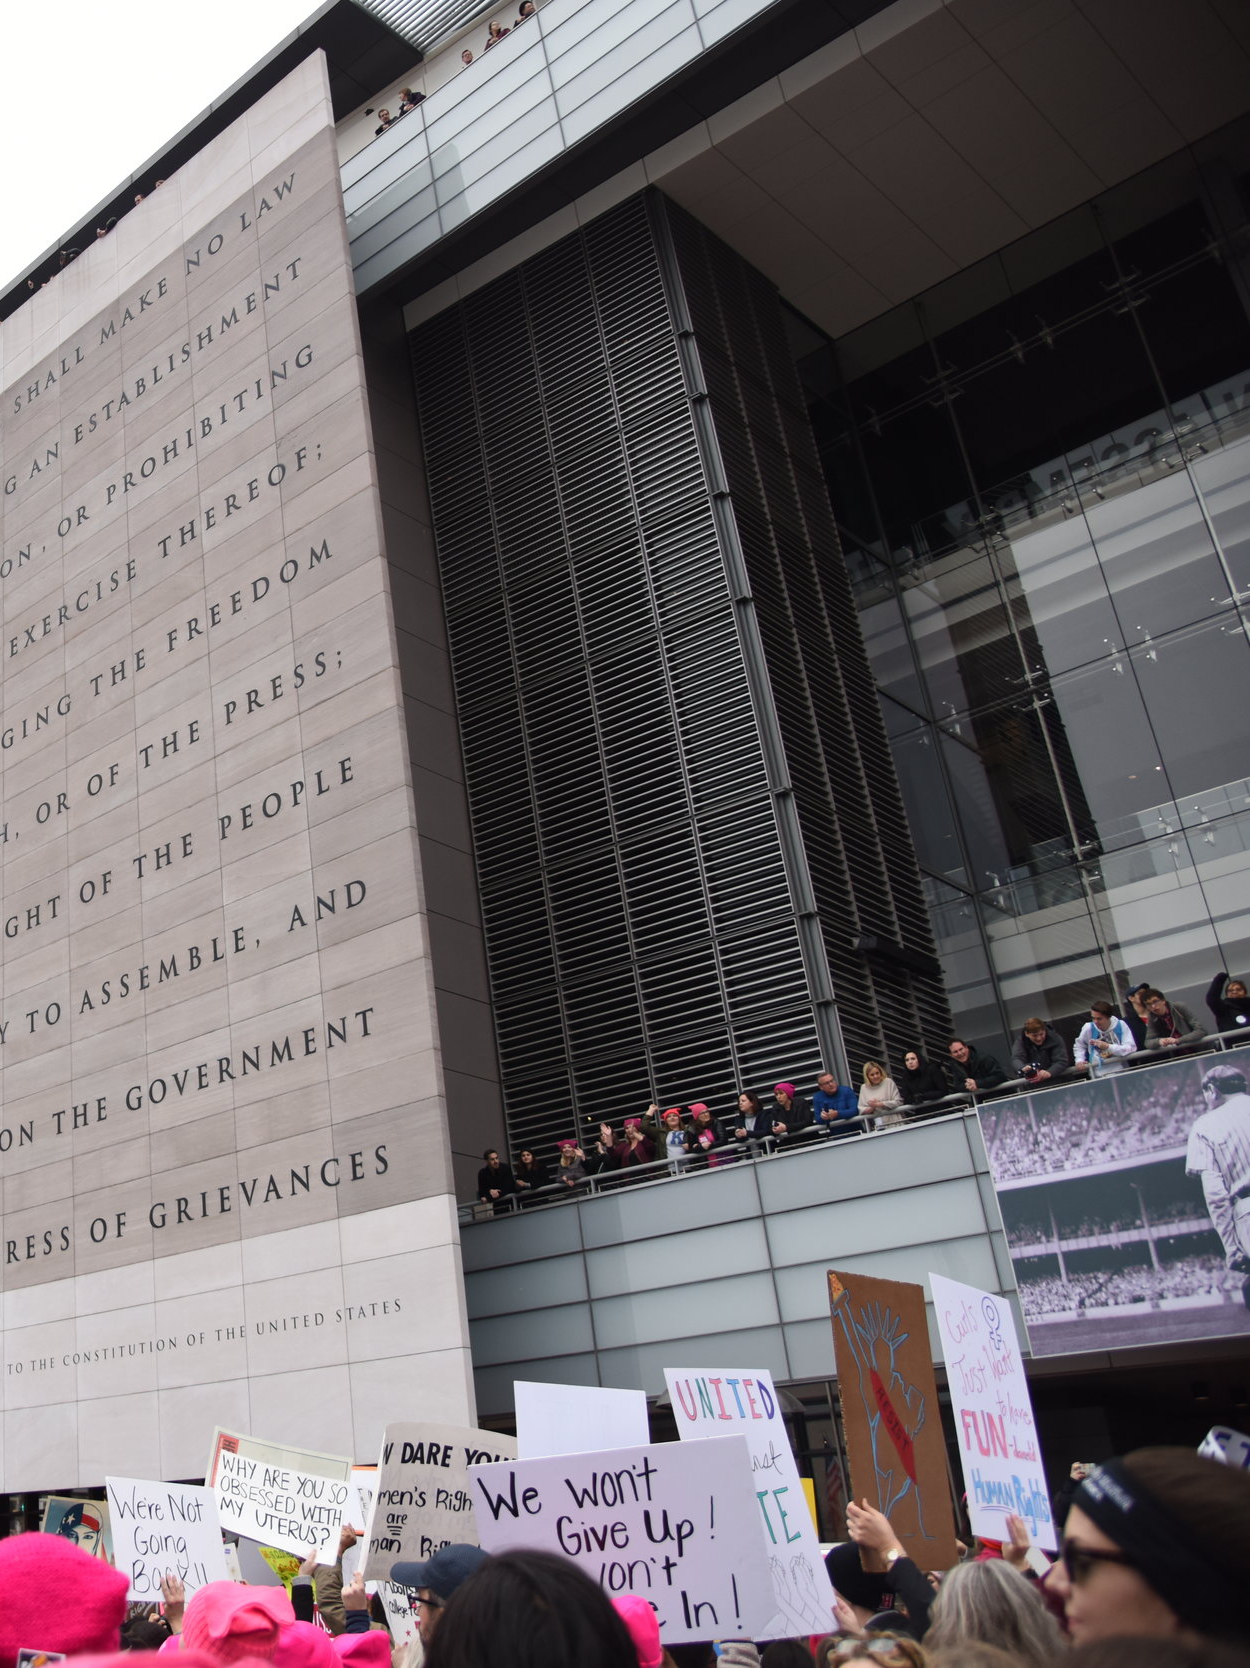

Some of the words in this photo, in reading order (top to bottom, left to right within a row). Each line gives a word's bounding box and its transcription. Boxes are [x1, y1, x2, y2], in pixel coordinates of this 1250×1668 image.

[14, 346, 84, 411] SHALL
[100, 276, 168, 340] MAKE
[185, 233, 224, 277] NO
[239, 172, 295, 233] LAW
[28, 441, 59, 480] AN
[73, 256, 301, 446] ESTABLISHMENT
[56, 504, 90, 539] OR
[105, 343, 313, 506] PROHIBITING
[8, 558, 137, 659] EXERCISE
[156, 443, 322, 560] THEREOF;
[88, 647, 146, 698] THE
[165, 538, 333, 654] FREEDOM
[34, 791, 71, 825] OR
[85, 762, 119, 798] OF
[138, 718, 200, 770] THE
[223, 649, 342, 727] PRESS;
[78, 869, 112, 905] OF
[131, 831, 193, 881] THE
[217, 755, 354, 842] PEOPLE
[24, 1001, 62, 1035] TO
[78, 925, 261, 1016] ASSEMBLE,
[286, 878, 367, 934] AND
[50, 1095, 108, 1137] THE
[124, 1006, 374, 1113] GOVERNMENT
[88, 1210, 127, 1245] OF
[147, 1143, 389, 1231] GRIEVANCES
[7, 1361, 24, 1375] TO
[30, 1356, 55, 1371] THE
[62, 1336, 178, 1367] CONSTITUTION
[186, 1332, 206, 1347] OF
[215, 1325, 246, 1341] THE
[256, 1312, 326, 1336] UNITED
[335, 1298, 402, 1322] STATES
[675, 1377, 775, 1421] UNITED
[951, 1353, 987, 1397] Just
[876, 1387, 910, 1452] RESIST
[223, 1454, 257, 1480] WHY
[262, 1468, 290, 1491] ARE
[296, 1475, 325, 1500] YOU
[328, 1483, 348, 1505] SO
[400, 1442, 453, 1468] DARE
[168, 1493, 204, 1523] Not
[220, 1475, 296, 1515] OBSESSED
[301, 1502, 343, 1527] WITH
[220, 1496, 244, 1519] MY
[255, 1508, 331, 1551] UTERUS?
[377, 1485, 427, 1508] men's
[435, 1487, 474, 1513] Righ
[386, 1511, 409, 1526] are
[477, 1471, 542, 1521] We
[756, 1486, 801, 1545] TE
[134, 1525, 190, 1571] Going
[369, 1535, 402, 1554] man
[556, 1514, 630, 1557] Give
